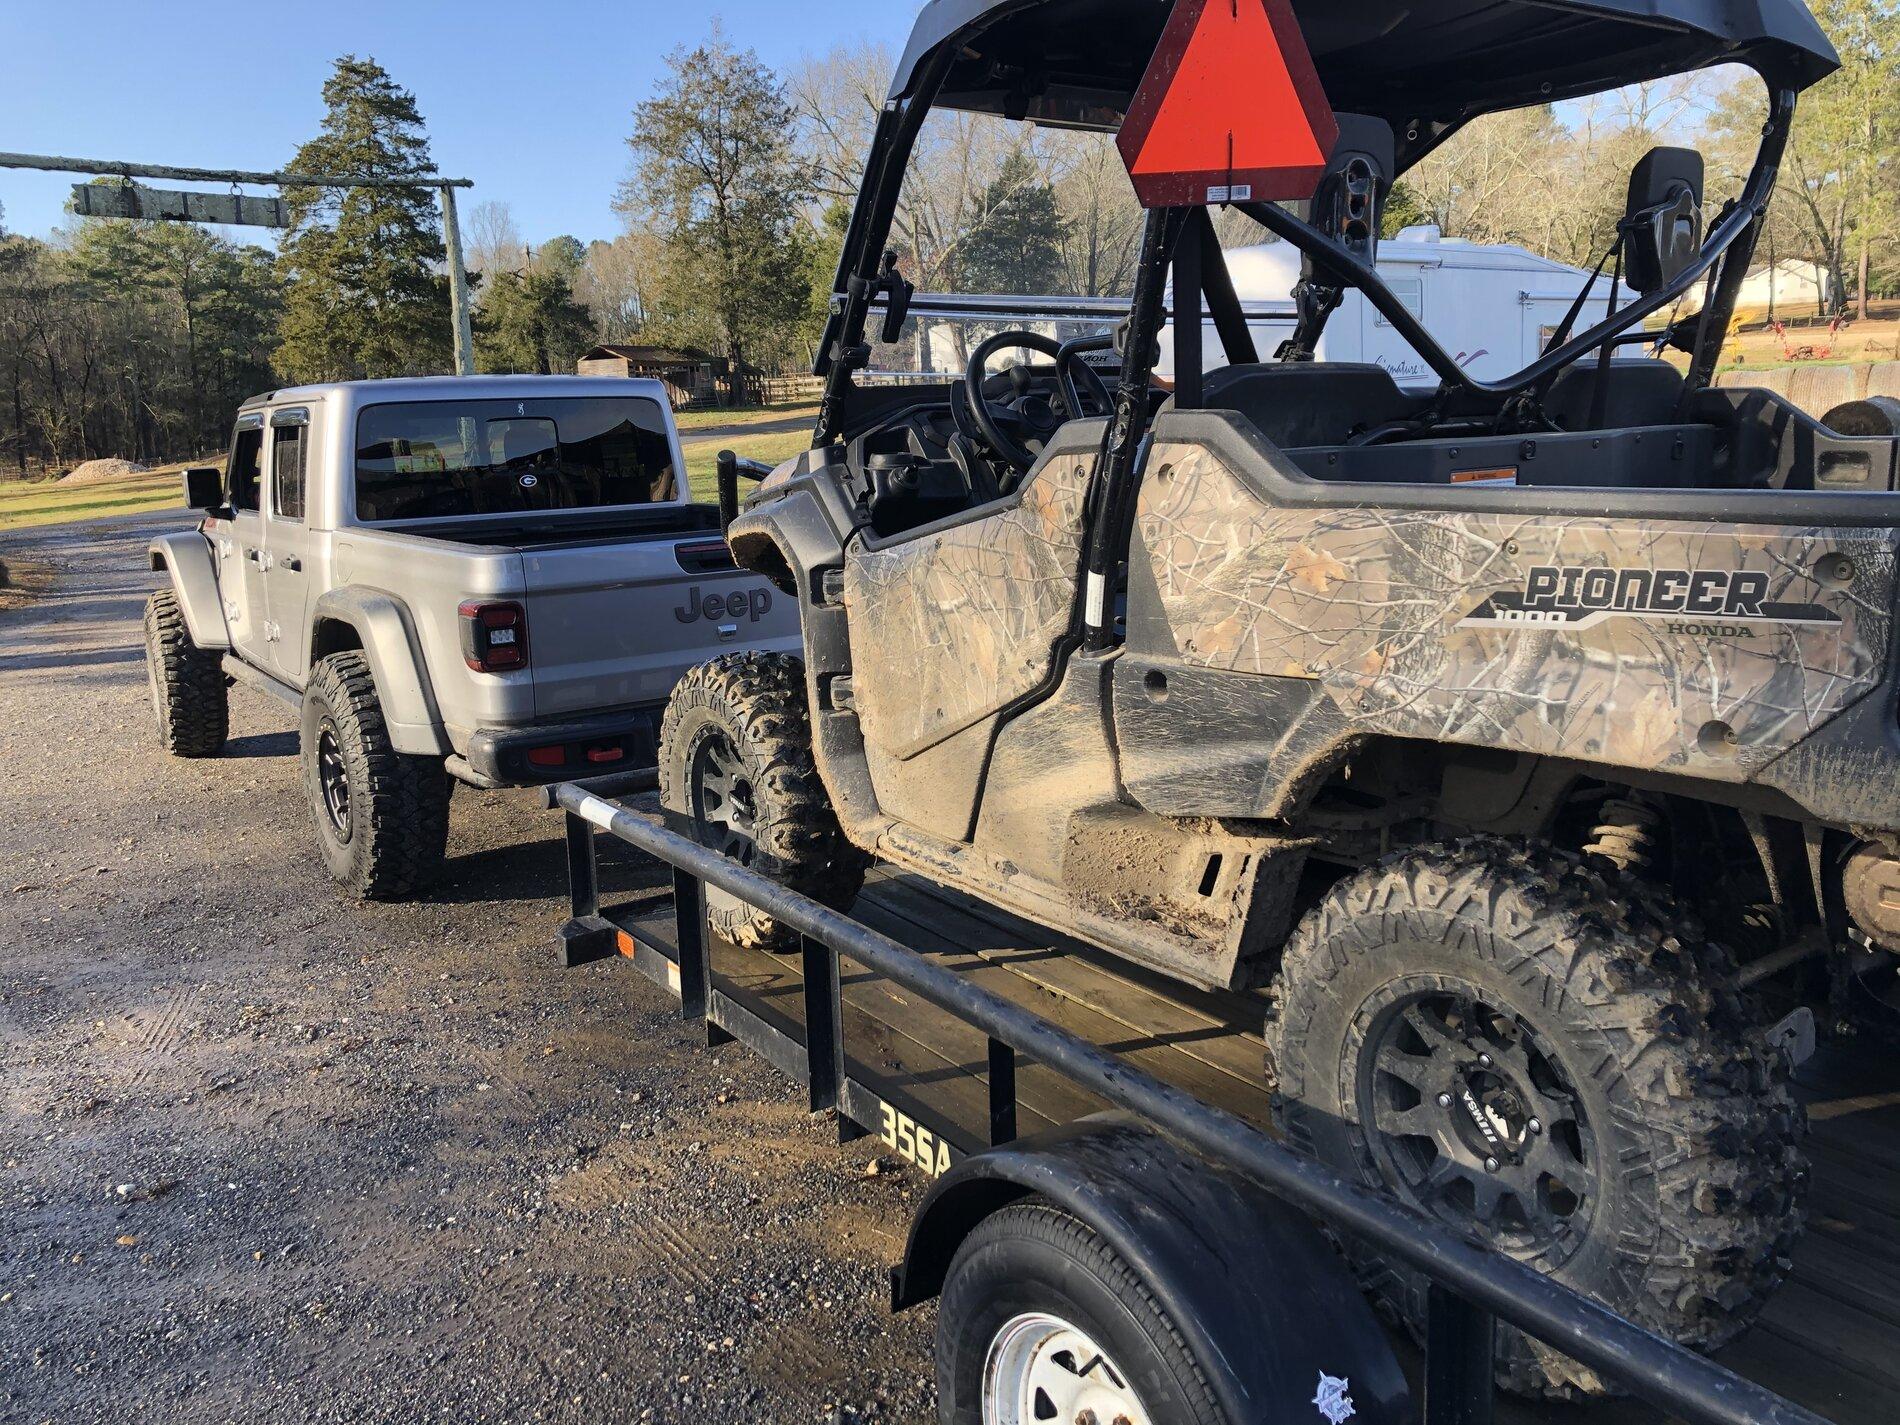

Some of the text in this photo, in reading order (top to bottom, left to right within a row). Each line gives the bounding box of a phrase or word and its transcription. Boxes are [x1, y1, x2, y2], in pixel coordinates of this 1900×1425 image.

[674, 586, 773, 624] Jeep
[1523, 566, 1771, 616] PIONEER
[1494, 610, 1567, 623] 1000
[1667, 623, 1756, 638] HONDA
[879, 1100, 952, 1179] 35SA
